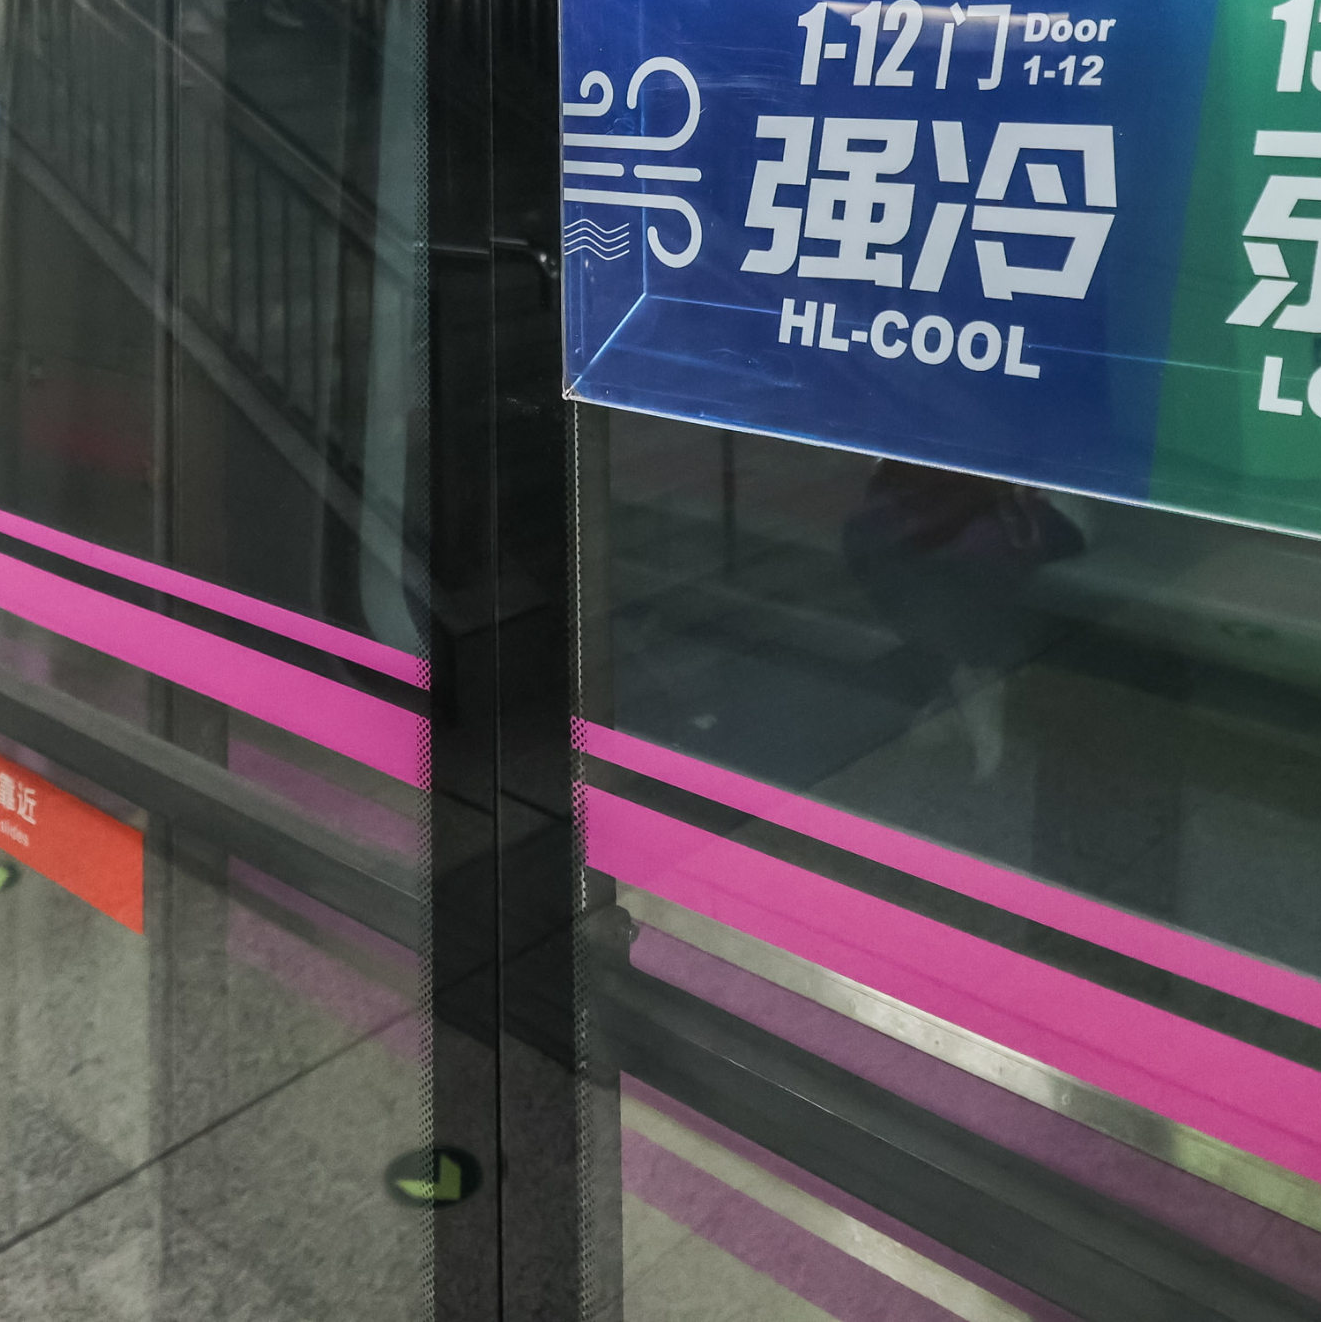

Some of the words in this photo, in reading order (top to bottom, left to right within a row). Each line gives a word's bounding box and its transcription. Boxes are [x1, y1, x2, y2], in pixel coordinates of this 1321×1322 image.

[796, 0, 1011, 91] 1-12门
[1023, 12, 1116, 43] Door
[1023, 55, 1104, 87] 1-12
[740, 115, 1118, 301] 强冷
[777, 298, 1040, 379] HL-COOL
